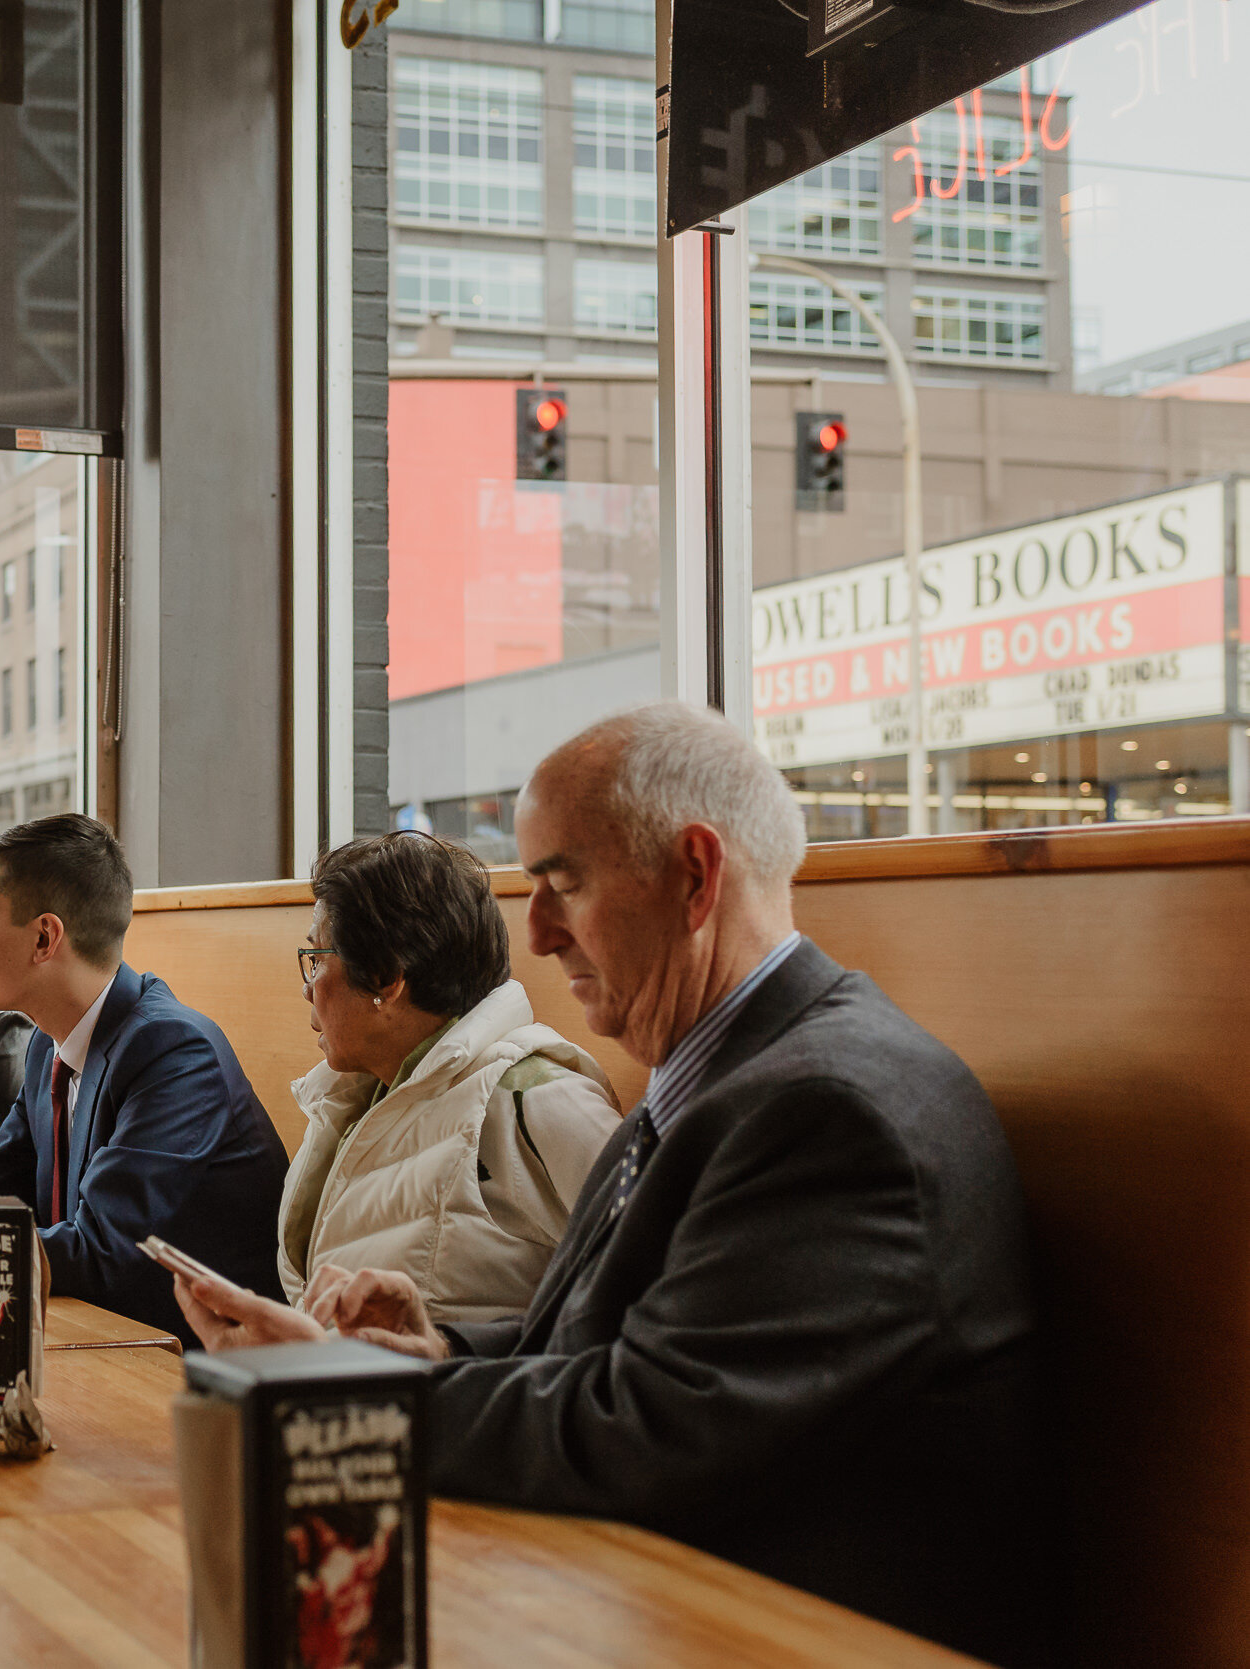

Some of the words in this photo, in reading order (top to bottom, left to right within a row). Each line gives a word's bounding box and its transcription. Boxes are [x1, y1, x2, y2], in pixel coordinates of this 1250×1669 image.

[972, 503, 1188, 608] BOOKS
[753, 660, 836, 710] USED
[850, 654, 871, 696] &
[979, 601, 1133, 671] BOOKS
